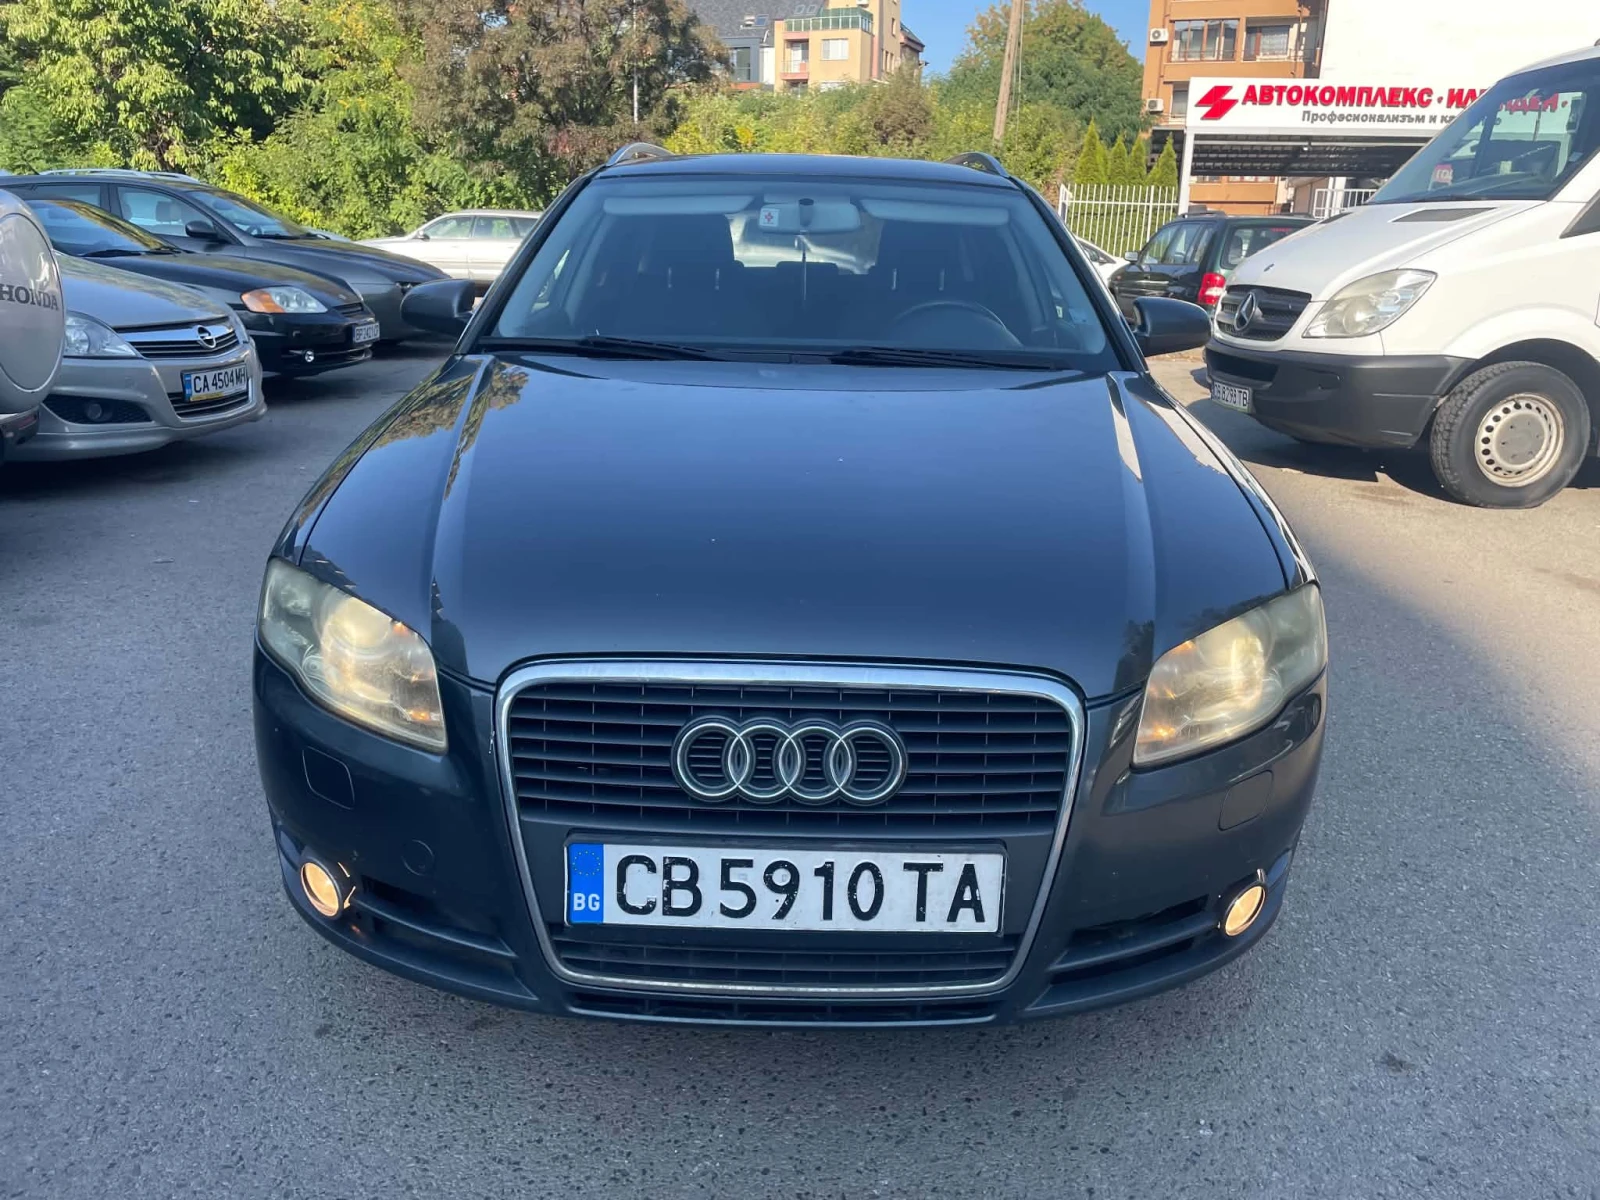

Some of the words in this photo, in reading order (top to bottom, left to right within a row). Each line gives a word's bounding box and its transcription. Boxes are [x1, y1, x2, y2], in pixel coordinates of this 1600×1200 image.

[1241, 84, 1433, 108] АВТОКОМПЛЕКС
[1302, 110, 1425, 124] Професионализъм
[0, 283, 59, 311] HONDA
[193, 375, 210, 393] CA
[212, 370, 235, 390] 4504
[617, 854, 701, 916] CB
[719, 858, 884, 922] 5910
[902, 862, 986, 923] TA
[573, 892, 600, 911] BG
